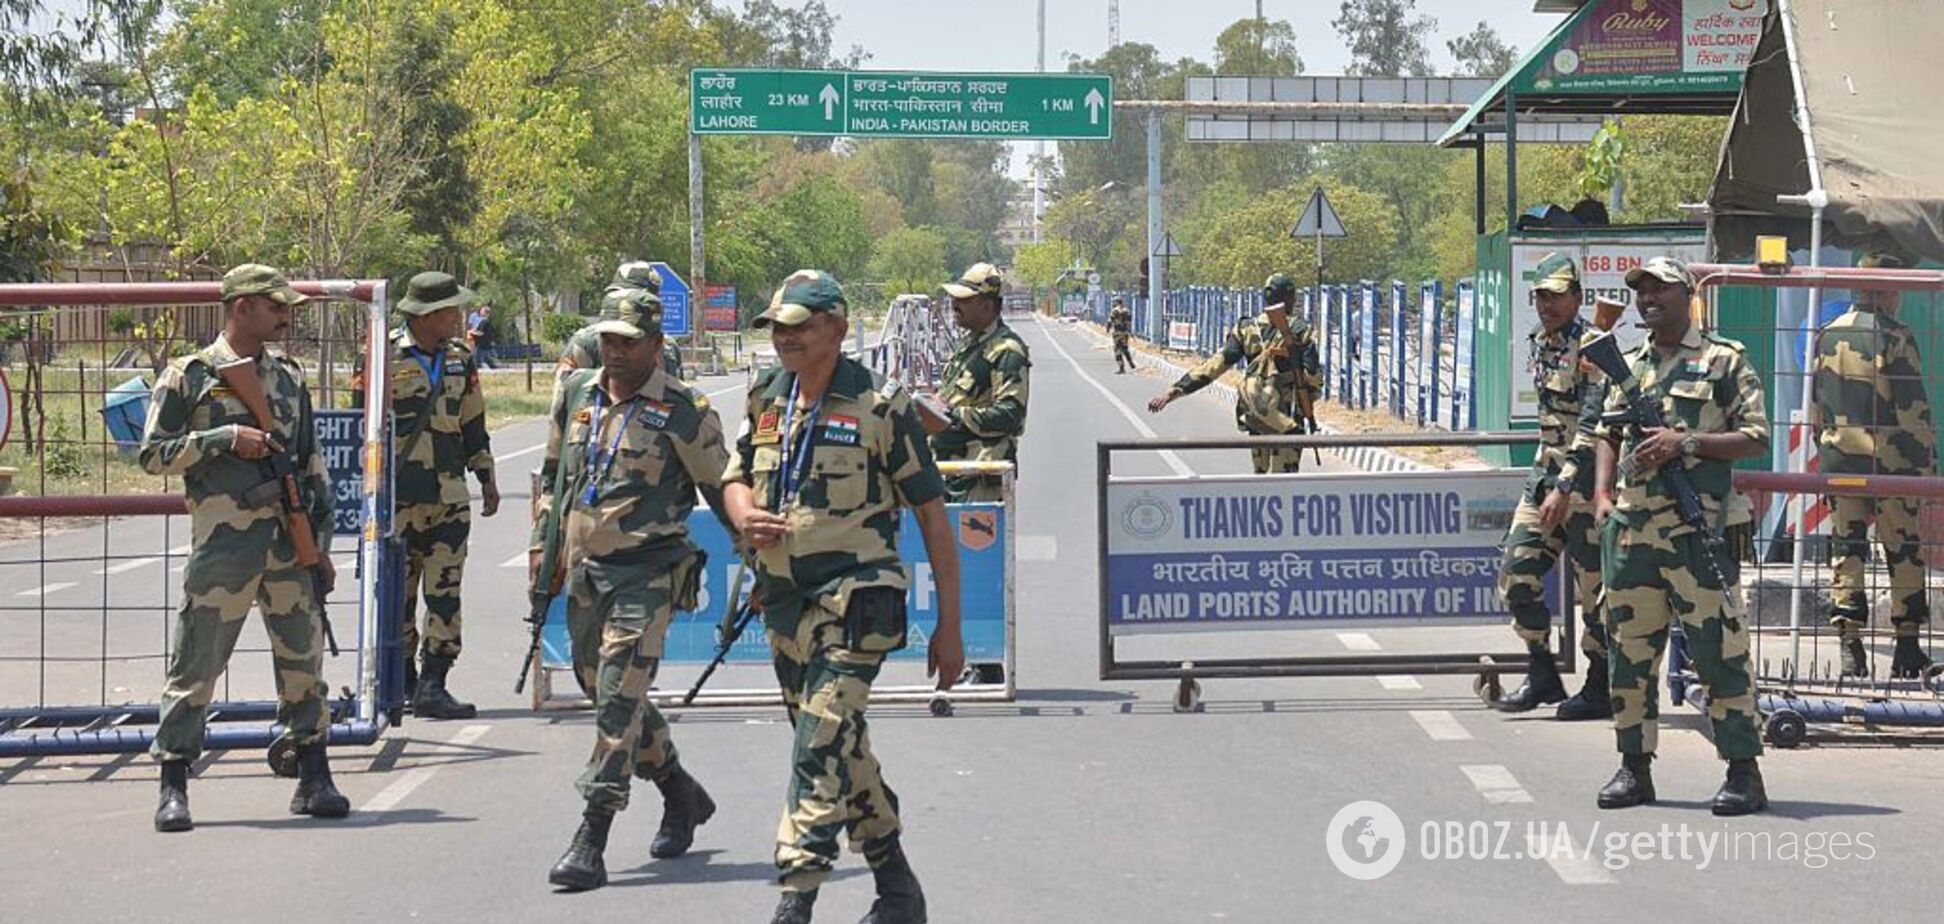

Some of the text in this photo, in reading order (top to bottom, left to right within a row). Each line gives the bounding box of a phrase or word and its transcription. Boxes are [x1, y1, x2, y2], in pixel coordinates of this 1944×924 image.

[1602, 11, 1669, 32] Ruby
[768, 94, 809, 106] 23 KM
[970, 96, 1004, 113] सीमा
[1042, 99, 1073, 111] 1 KM
[700, 115, 758, 128] LAHORE
[852, 118, 889, 130] INDIA
[900, 119, 967, 131] PAKISTAN
[971, 120, 1030, 133] BORDER
[1582, 256, 1641, 271] 168 BN
[1180, 492, 1460, 538] THANKS FOR VISITING
[1153, 555, 1249, 582] भारतीय
[1259, 553, 1312, 587] भूमि
[1321, 557, 1383, 580] पत्तन
[1122, 594, 1190, 619] LAND
[1199, 591, 1280, 618] PORTS
[1288, 588, 1426, 616] AUTHORITY
[1434, 587, 1466, 613] OF
